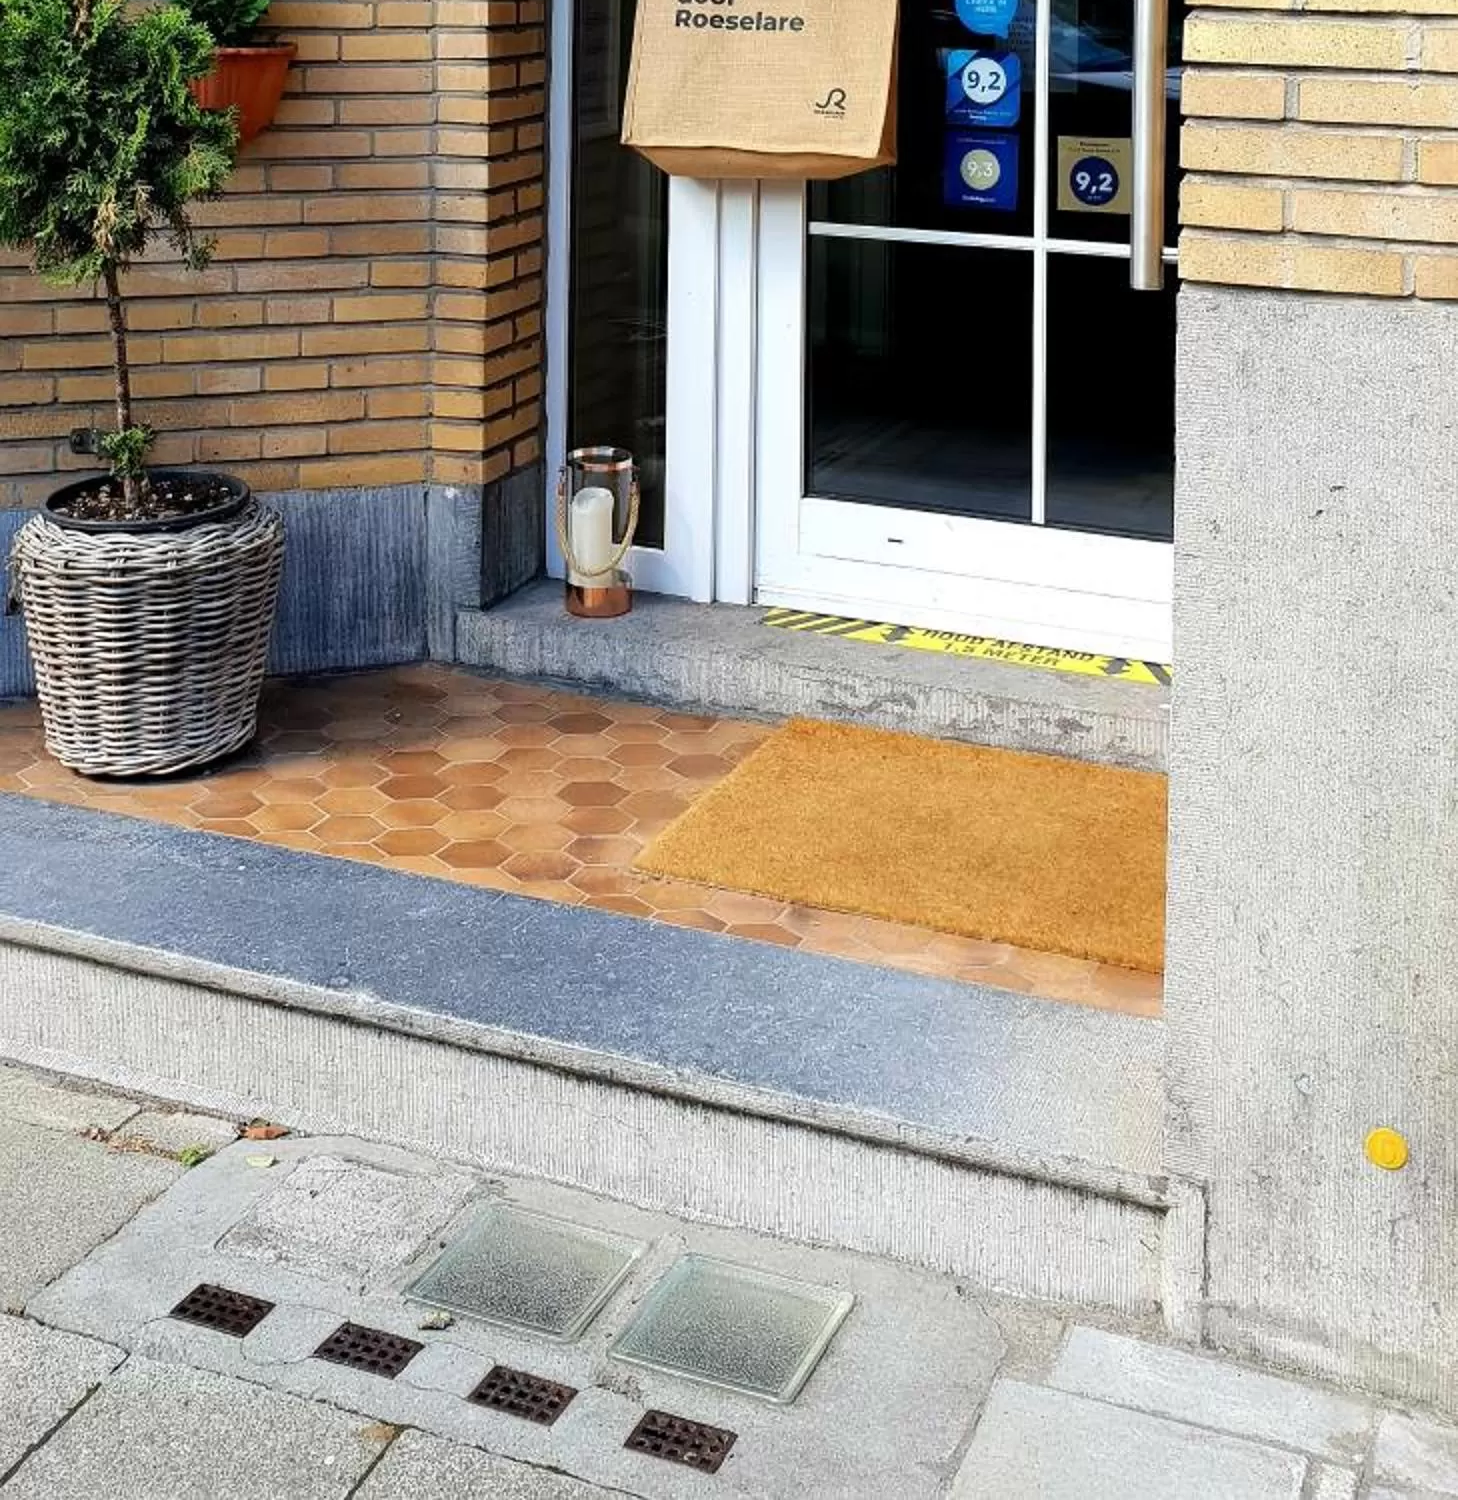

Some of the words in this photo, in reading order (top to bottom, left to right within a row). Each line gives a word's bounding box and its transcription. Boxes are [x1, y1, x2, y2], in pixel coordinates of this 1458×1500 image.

[674, 10, 805, 31] Roeselare
[967, 71, 1001, 92] 9,2
[1075, 171, 1113, 194] 9,2
[983, 648, 1060, 667] METER
